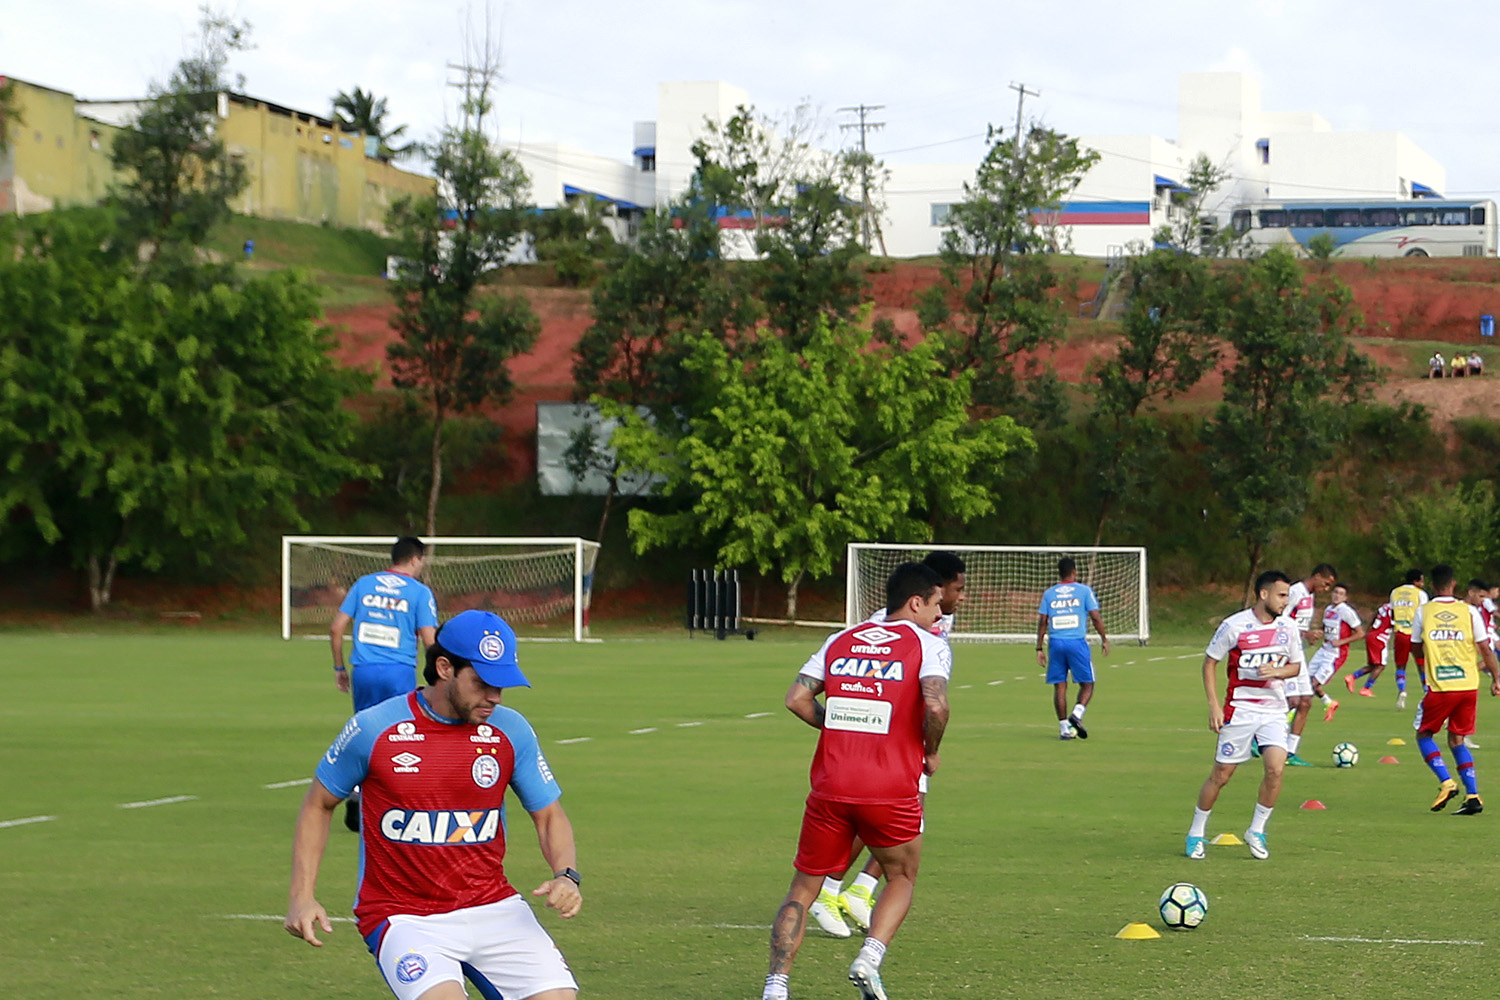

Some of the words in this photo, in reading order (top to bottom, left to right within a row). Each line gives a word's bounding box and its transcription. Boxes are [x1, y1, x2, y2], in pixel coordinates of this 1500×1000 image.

[362, 594, 409, 613] CAIXA
[1050, 598, 1080, 609] CAIXA
[1429, 629, 1464, 641] CAIXA
[850, 644, 892, 655] umbro
[829, 657, 904, 681] CAIXA
[830, 712, 869, 724] Unimed
[380, 808, 501, 844] CAIXA
